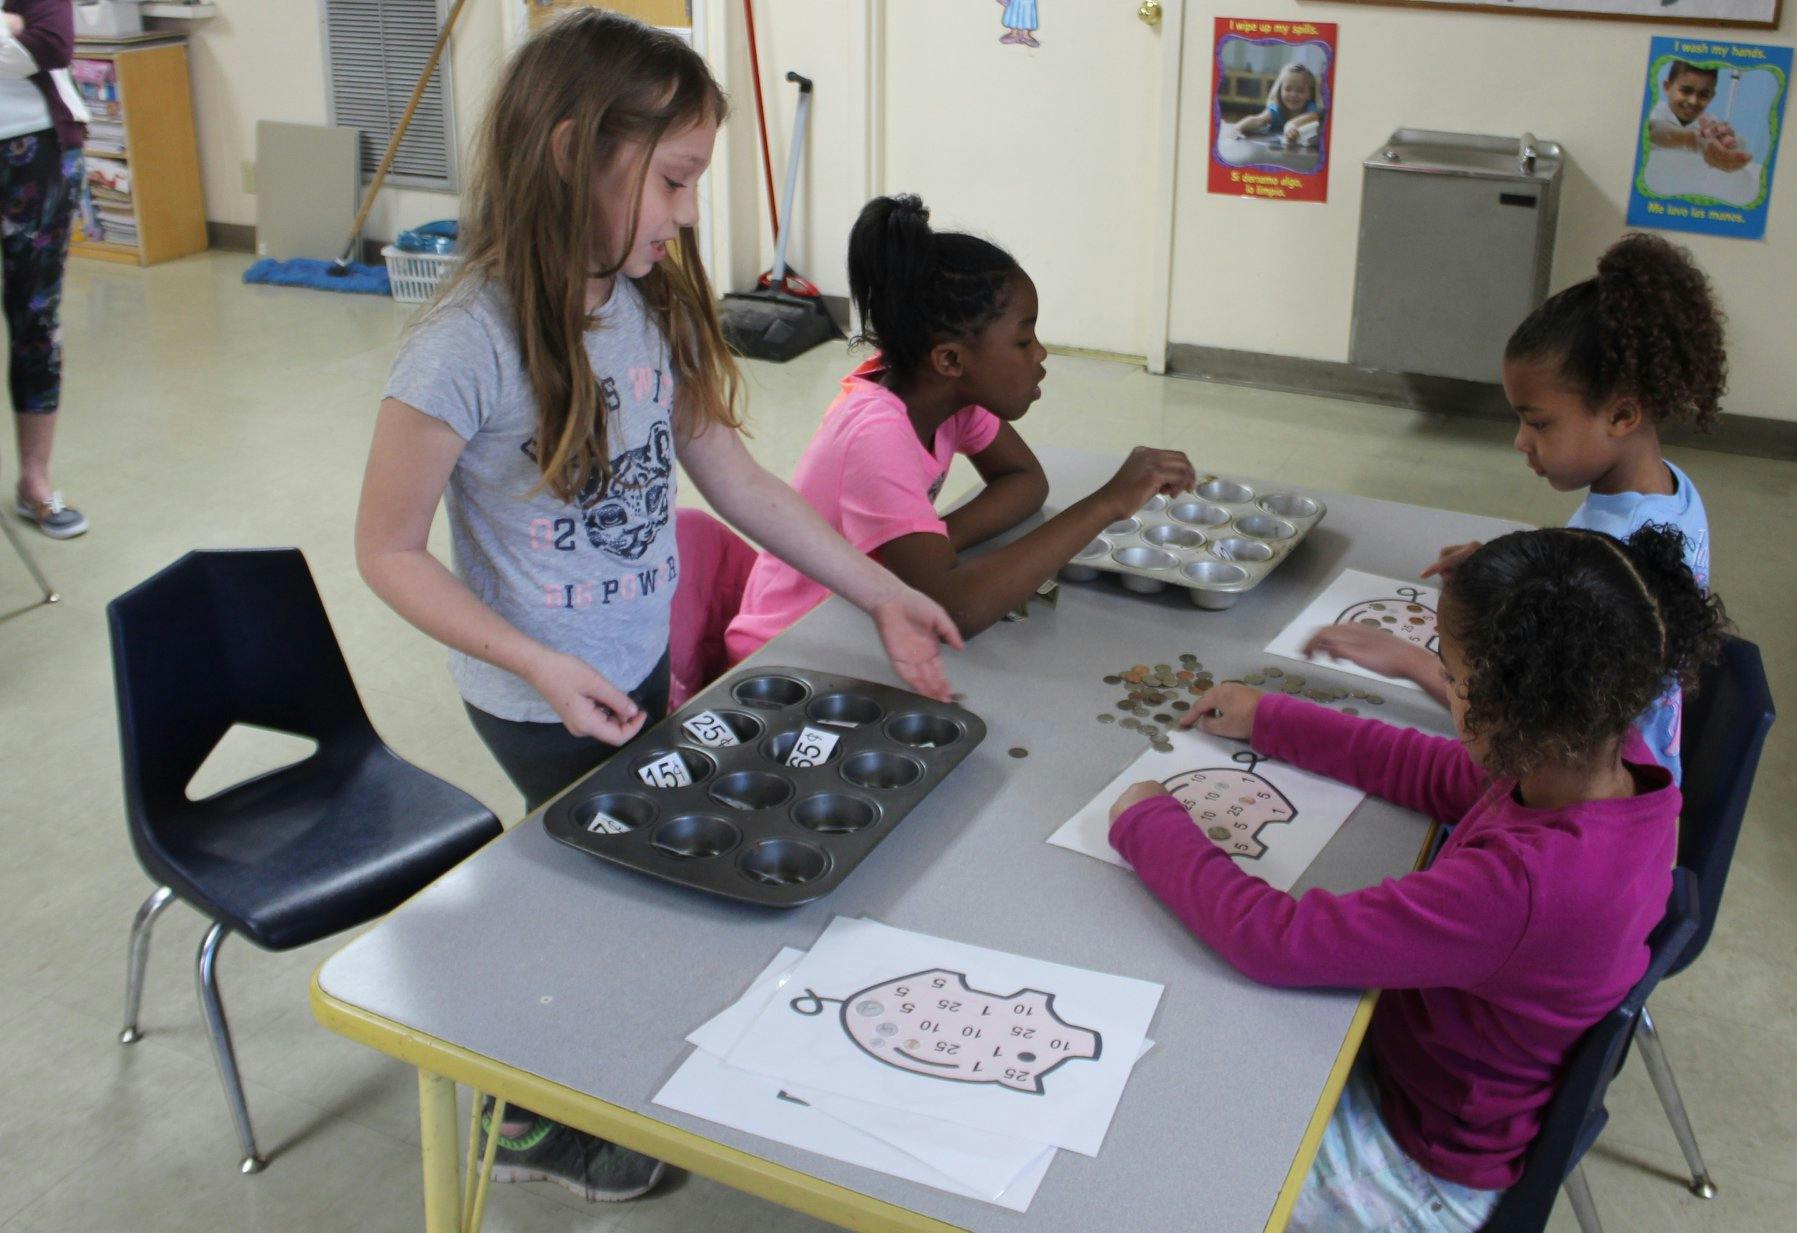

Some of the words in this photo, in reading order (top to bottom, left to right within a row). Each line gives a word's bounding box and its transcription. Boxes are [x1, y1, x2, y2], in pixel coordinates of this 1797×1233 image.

[1235, 22, 1257, 34] wipe
[1259, 23, 1272, 34] up
[1273, 24, 1289, 35] my
[1681, 42, 1708, 54] wash
[1711, 45, 1729, 58] my
[1246, 184, 1255, 195] lo
[1647, 201, 1664, 215] Me
[1690, 206, 1706, 219] las
[1191, 774, 1206, 783] 10
[1204, 791, 1220, 801] 10
[1256, 791, 1271, 800] 5
[1200, 810, 1217, 820] 10
[1226, 805, 1244, 817] 25
[1233, 821, 1248, 831] 5
[1233, 842, 1249, 851] 5
[931, 978, 946, 988] 5
[894, 986, 909, 997] 5
[899, 1002, 915, 1013] 5
[936, 999, 962, 1012] 25
[1013, 1004, 1033, 1016] 10
[920, 1020, 940, 1033] 10
[961, 1026, 982, 1039] 10
[1009, 1026, 1036, 1039] 25
[934, 1041, 960, 1055] 25
[1049, 1039, 1070, 1051] 10
[1003, 1068, 1030, 1082] 25
